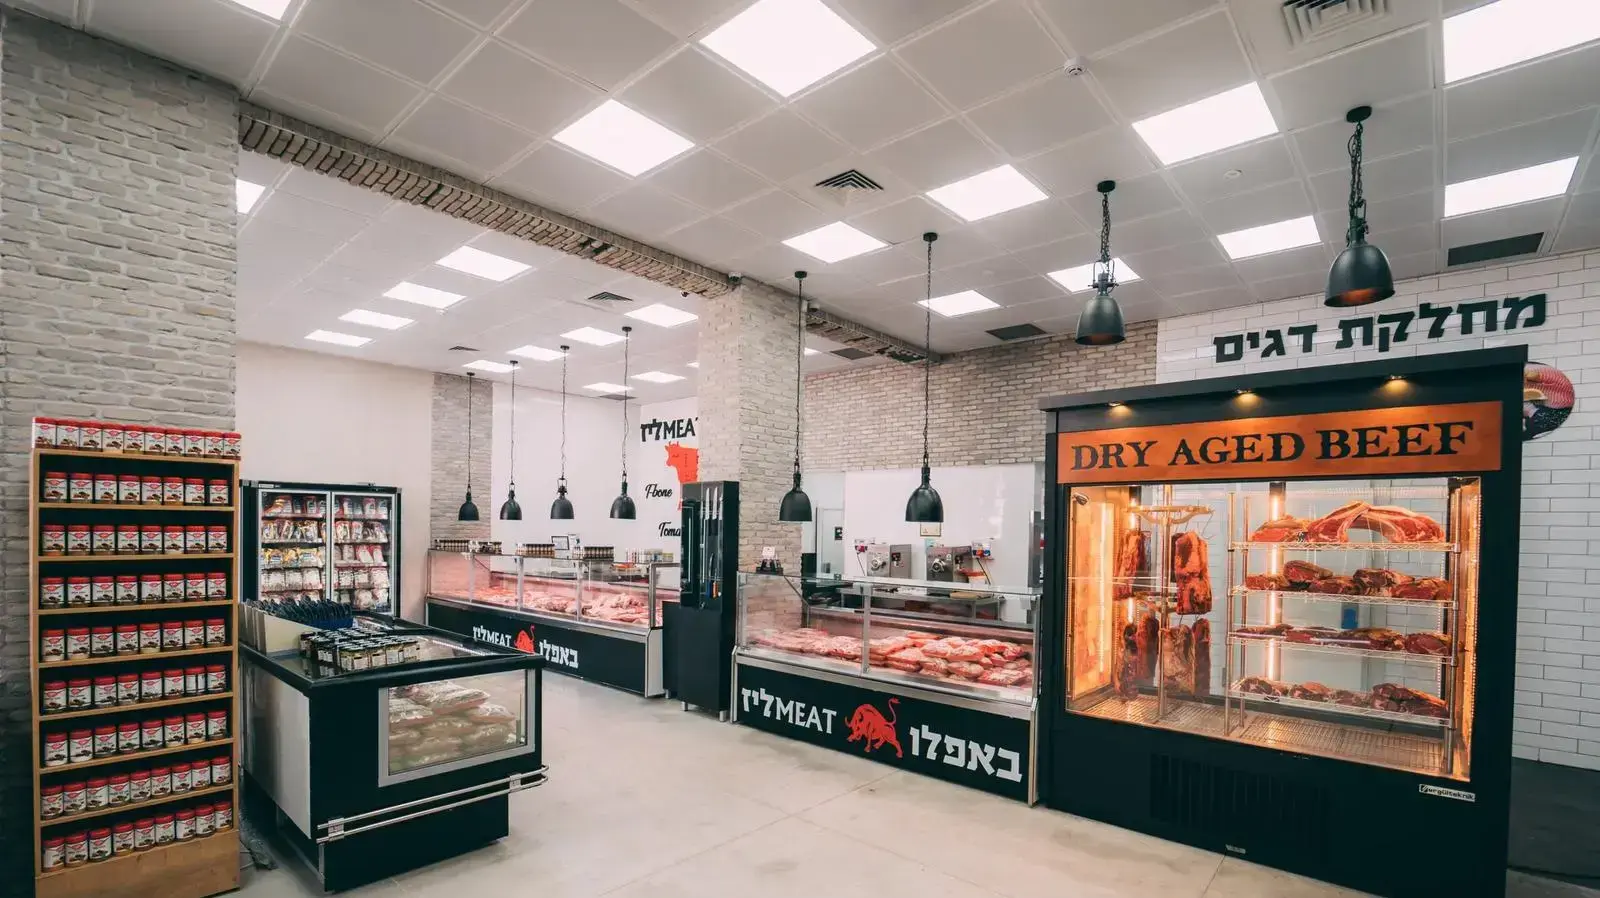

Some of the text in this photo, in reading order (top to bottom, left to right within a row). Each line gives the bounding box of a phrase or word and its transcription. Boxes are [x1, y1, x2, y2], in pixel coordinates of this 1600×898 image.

[1213, 293, 1546, 363] מחלקת דגים
[1071, 421, 1473, 470] DRY AGED BEEF
[539, 639, 579, 669] באפלו
[909, 724, 1023, 783] באפלו
